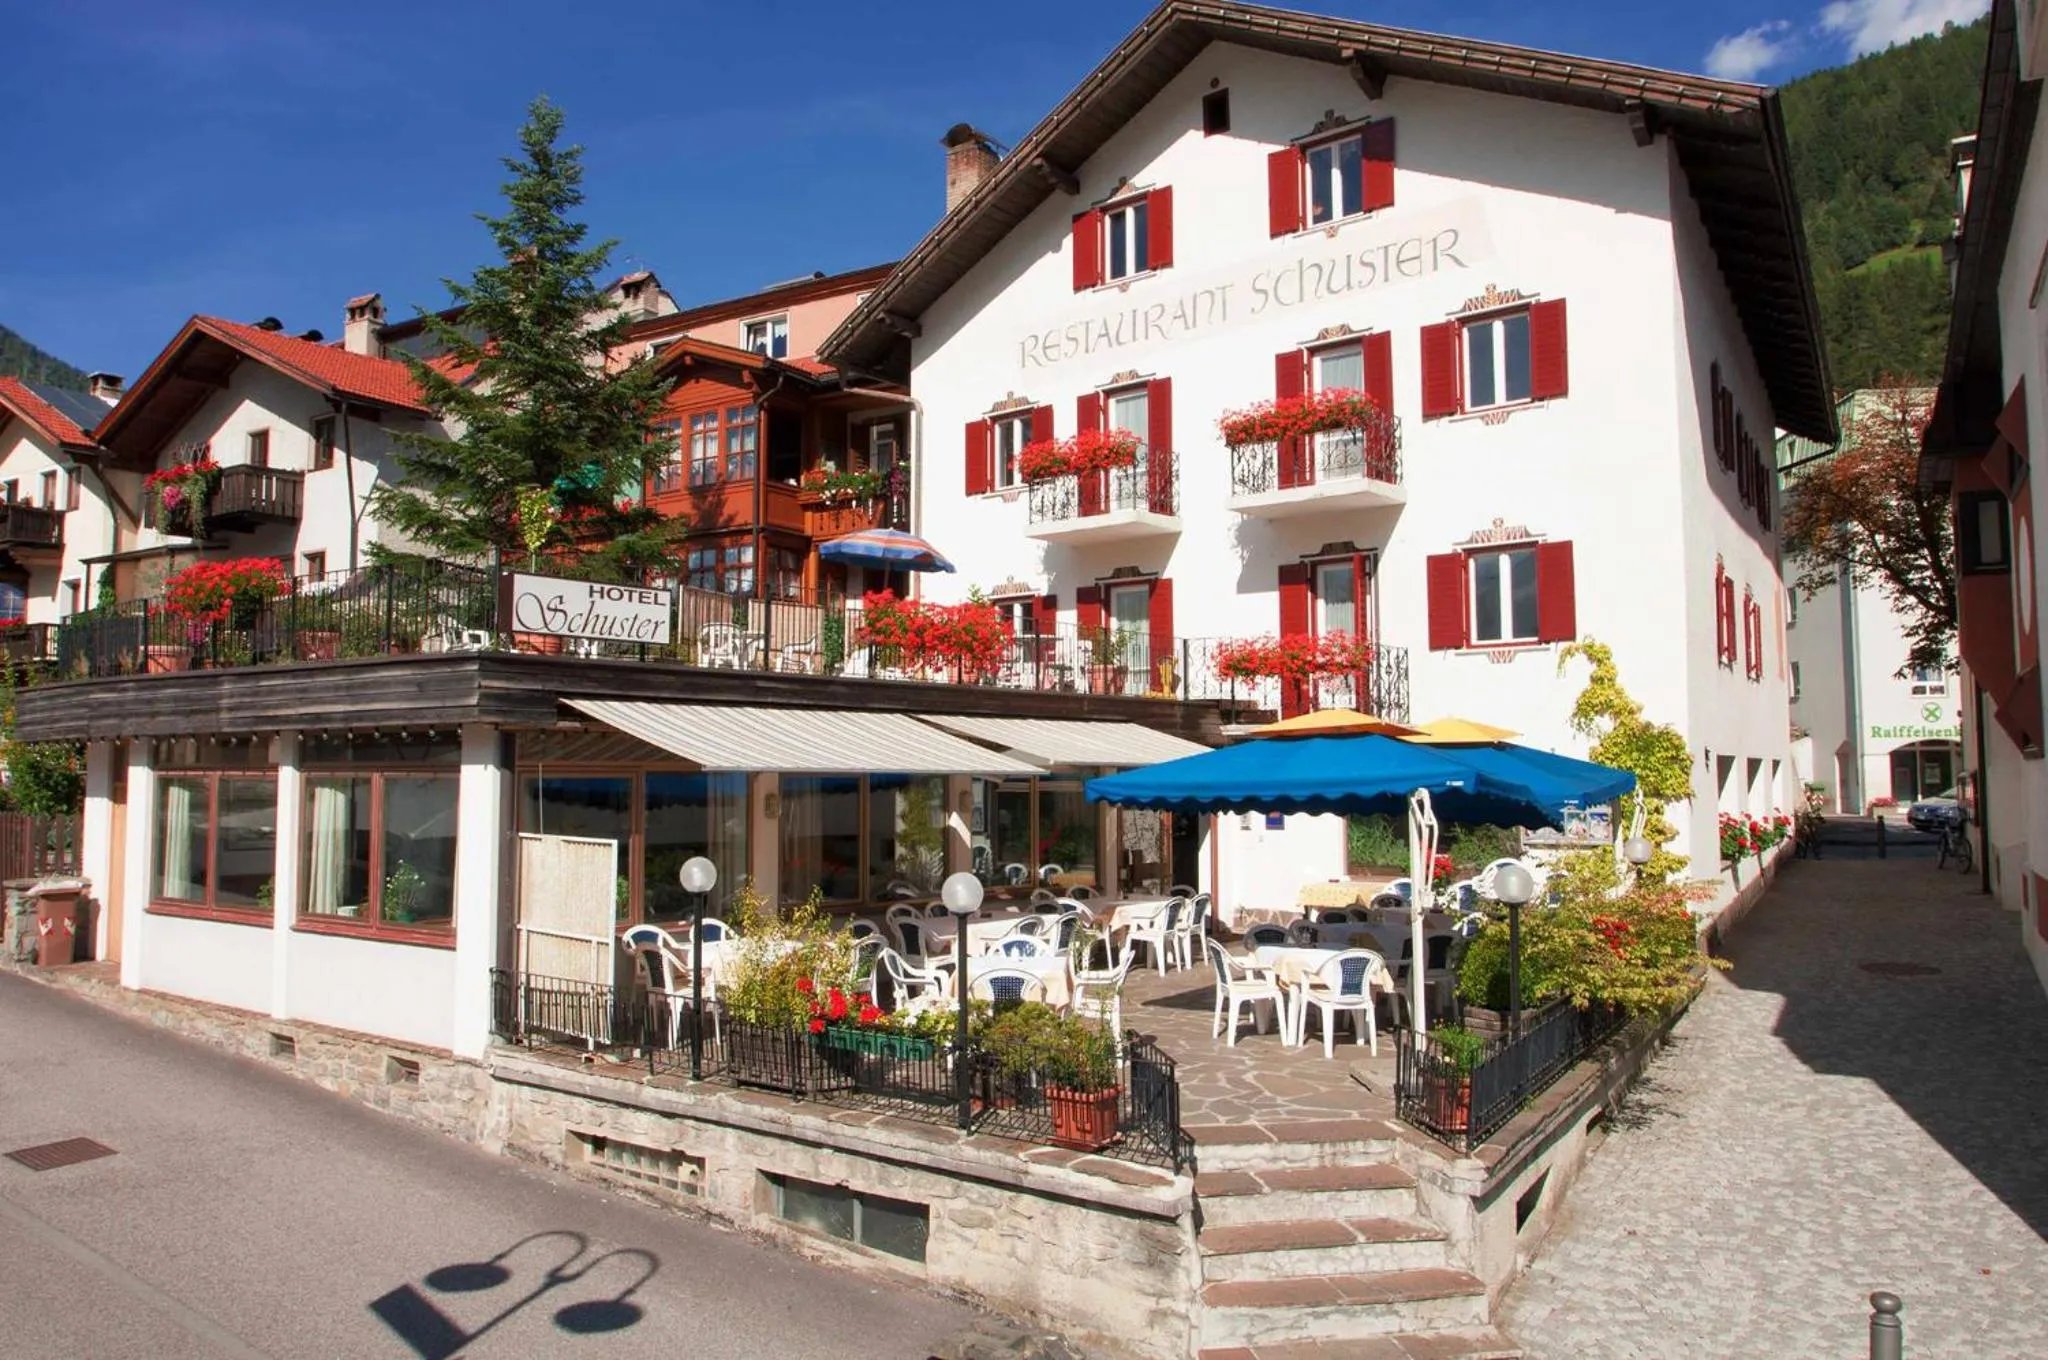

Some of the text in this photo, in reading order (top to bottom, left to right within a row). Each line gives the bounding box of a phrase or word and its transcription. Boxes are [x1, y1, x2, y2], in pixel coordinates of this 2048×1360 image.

[1019, 282, 1235, 369] RESTAURANT
[515, 592, 666, 641] Schuster
[589, 584, 667, 607] HOTEL
